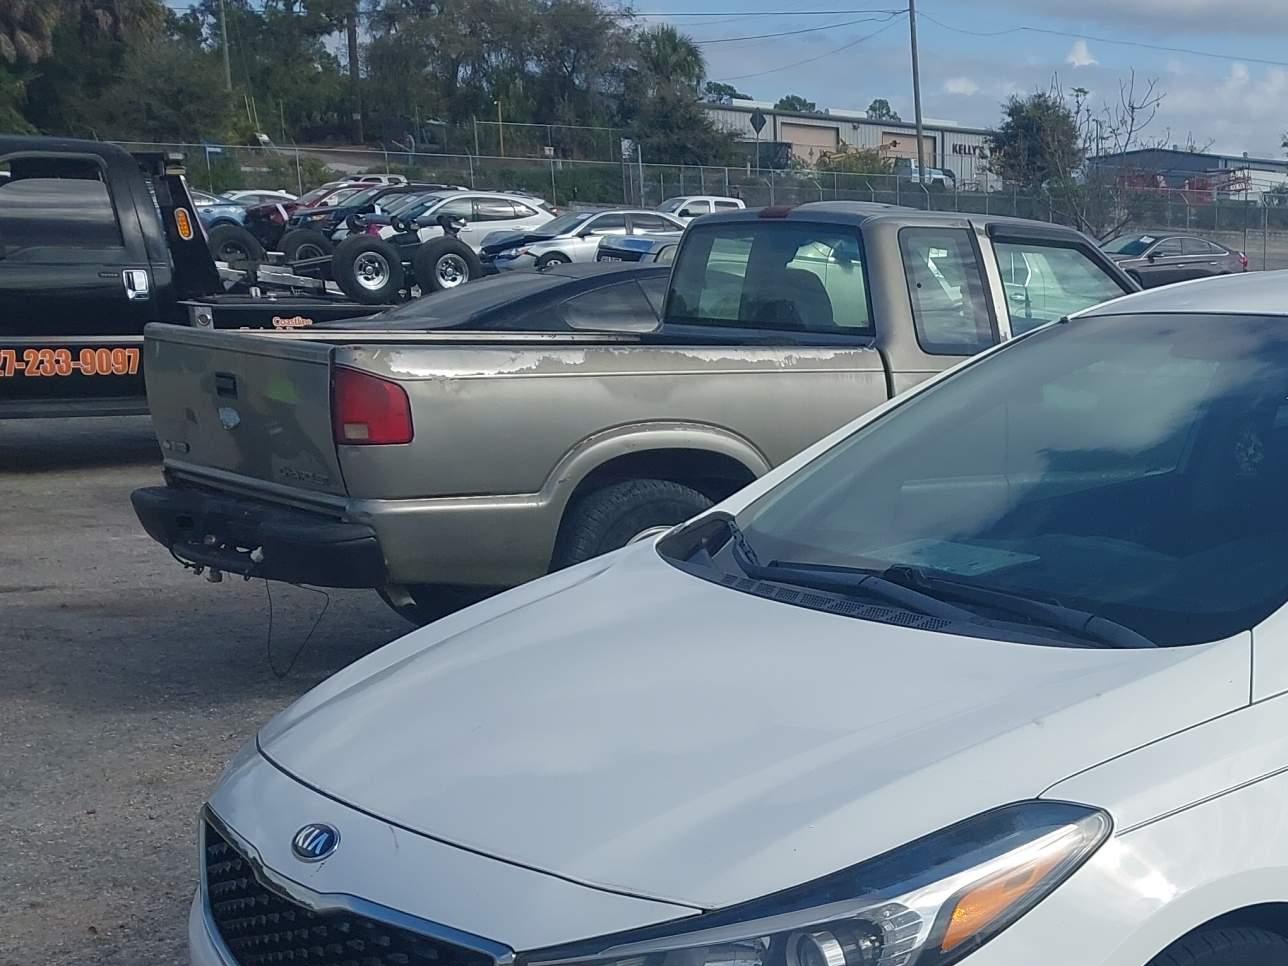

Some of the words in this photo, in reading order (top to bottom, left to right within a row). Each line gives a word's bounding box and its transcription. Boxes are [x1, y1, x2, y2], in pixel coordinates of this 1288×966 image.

[952, 143, 989, 160] KELLY'S
[0, 348, 140, 377] 7-233-9097
[295, 826, 329, 855] KIA
